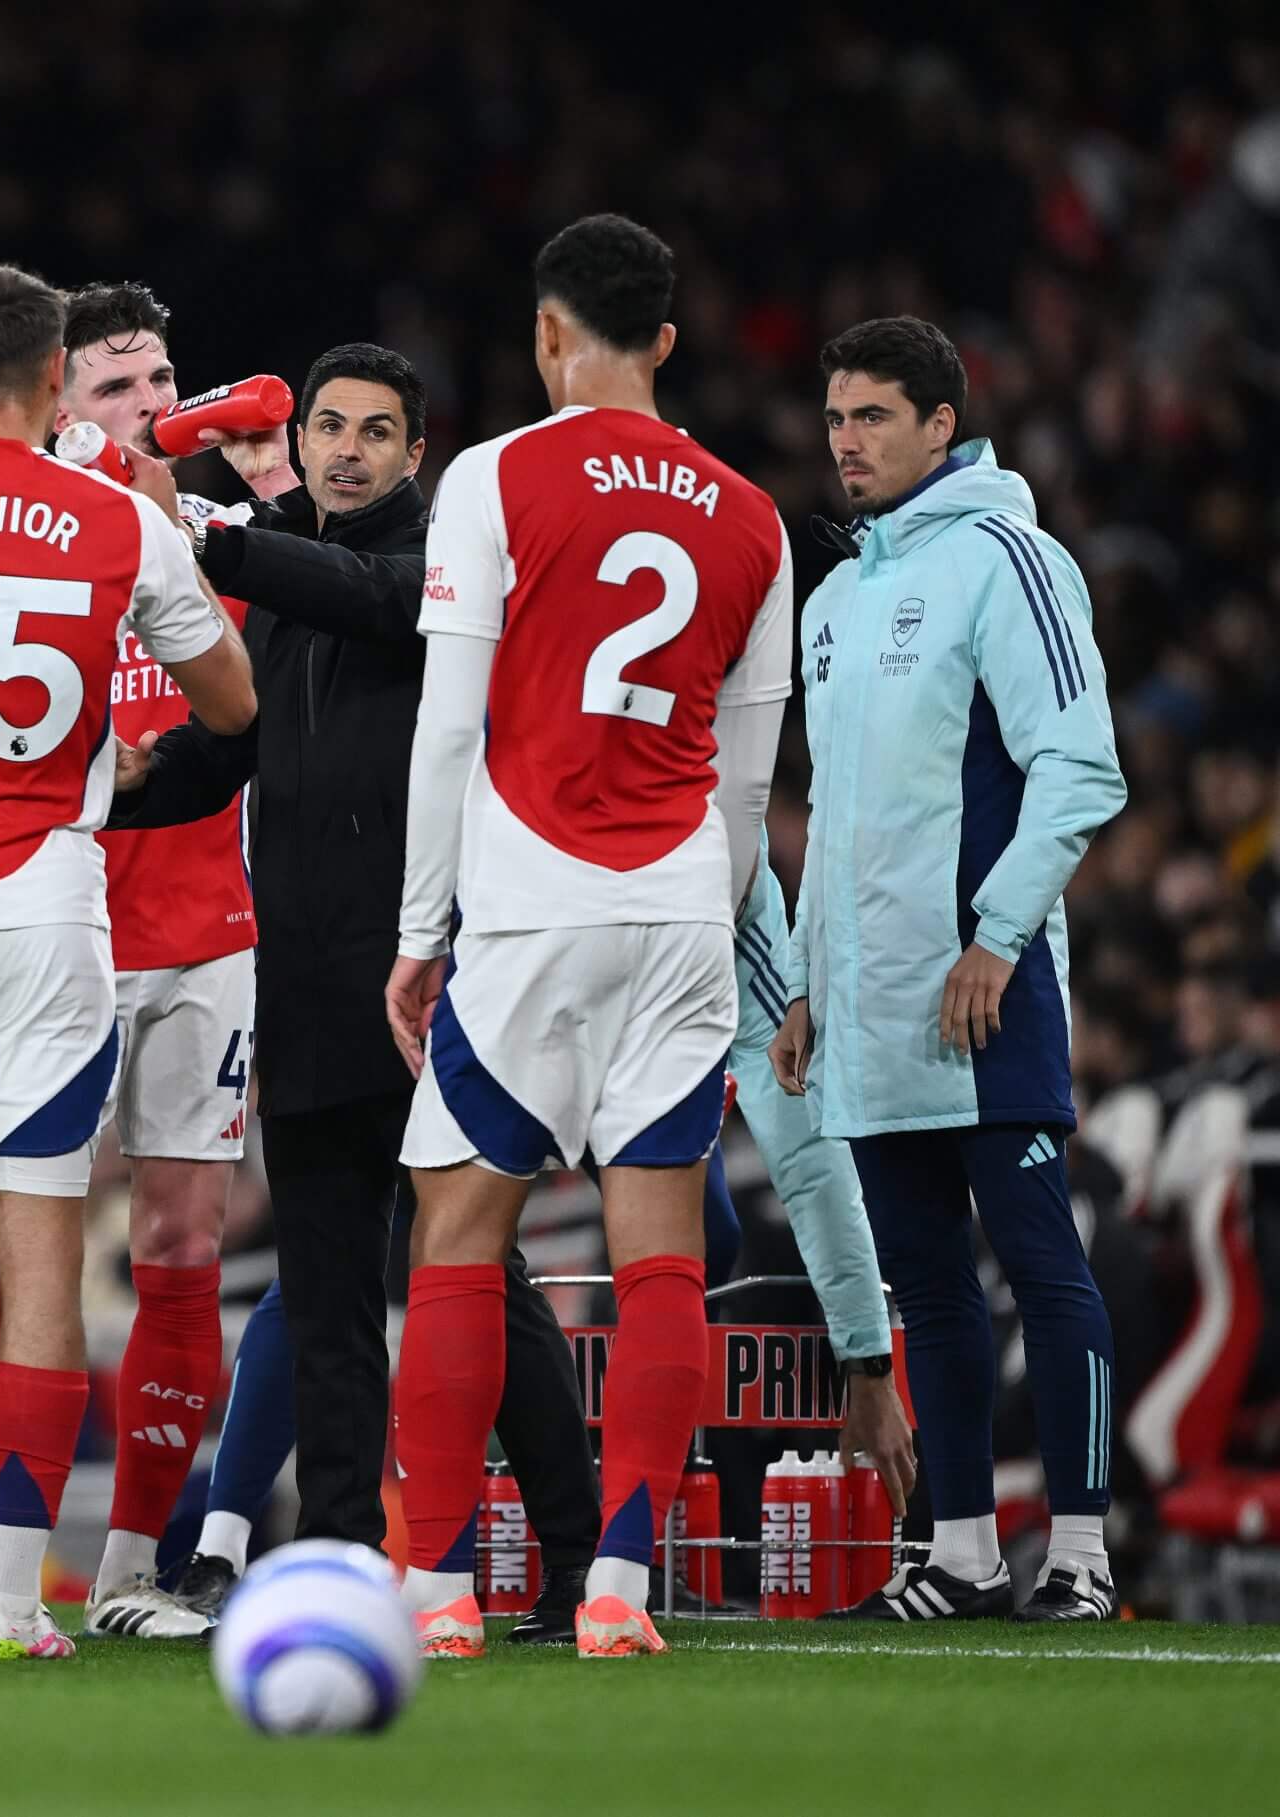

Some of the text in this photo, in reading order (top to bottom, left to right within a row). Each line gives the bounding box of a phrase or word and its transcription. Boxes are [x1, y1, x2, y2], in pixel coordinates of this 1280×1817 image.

[583, 454, 720, 519] SALIBA
[423, 584, 457, 602] NDA
[424, 566, 445, 583] SIT
[581, 531, 699, 727] 2
[879, 651, 920, 665] Emirates
[109, 663, 183, 704] BETTE
[216, 1029, 254, 1100] 4
[140, 1381, 206, 1410] AFC
[724, 1332, 849, 1421] PRIM
[490, 1502, 528, 1595] PRME
[760, 1502, 791, 1595] PRME
[792, 1501, 812, 1595] PRME
